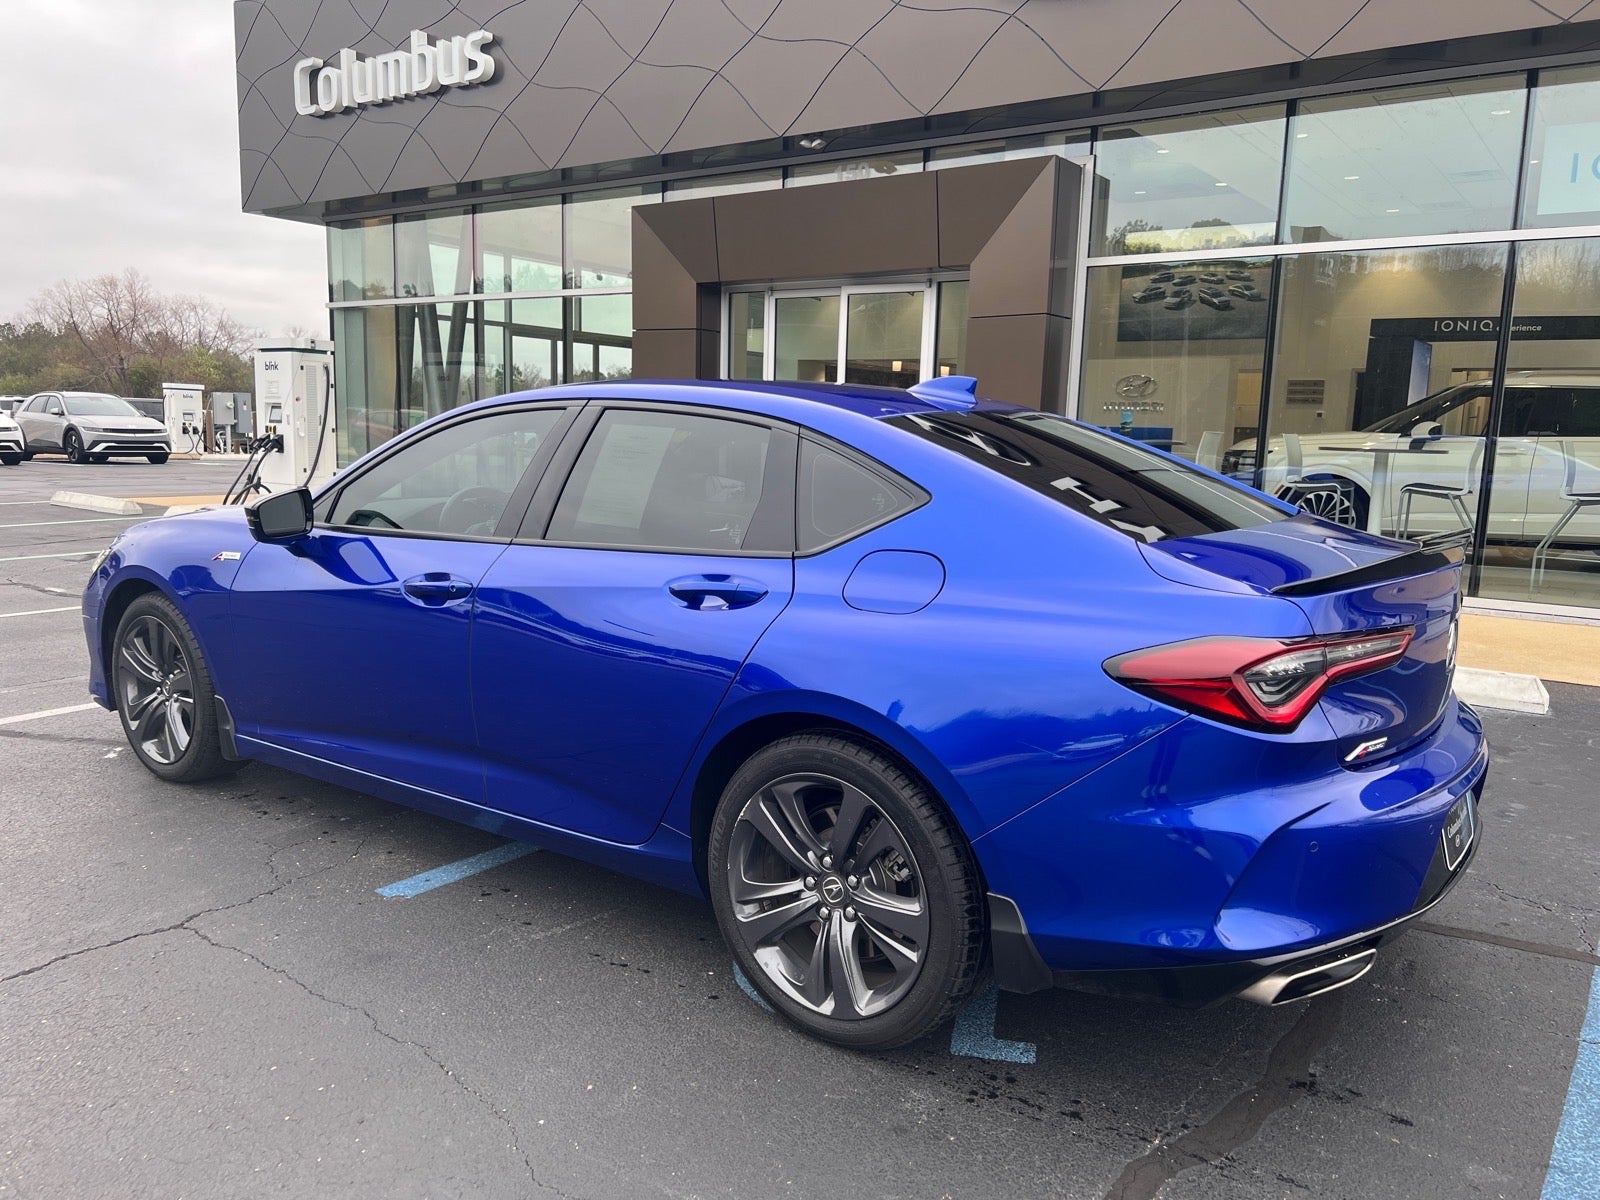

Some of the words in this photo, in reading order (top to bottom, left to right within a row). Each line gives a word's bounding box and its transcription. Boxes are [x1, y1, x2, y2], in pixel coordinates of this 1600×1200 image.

[293, 29, 495, 116] Columbus
[1434, 319, 1493, 332] IONIQ
[1496, 324, 1542, 332] eerience
[264, 360, 279, 371] blink
